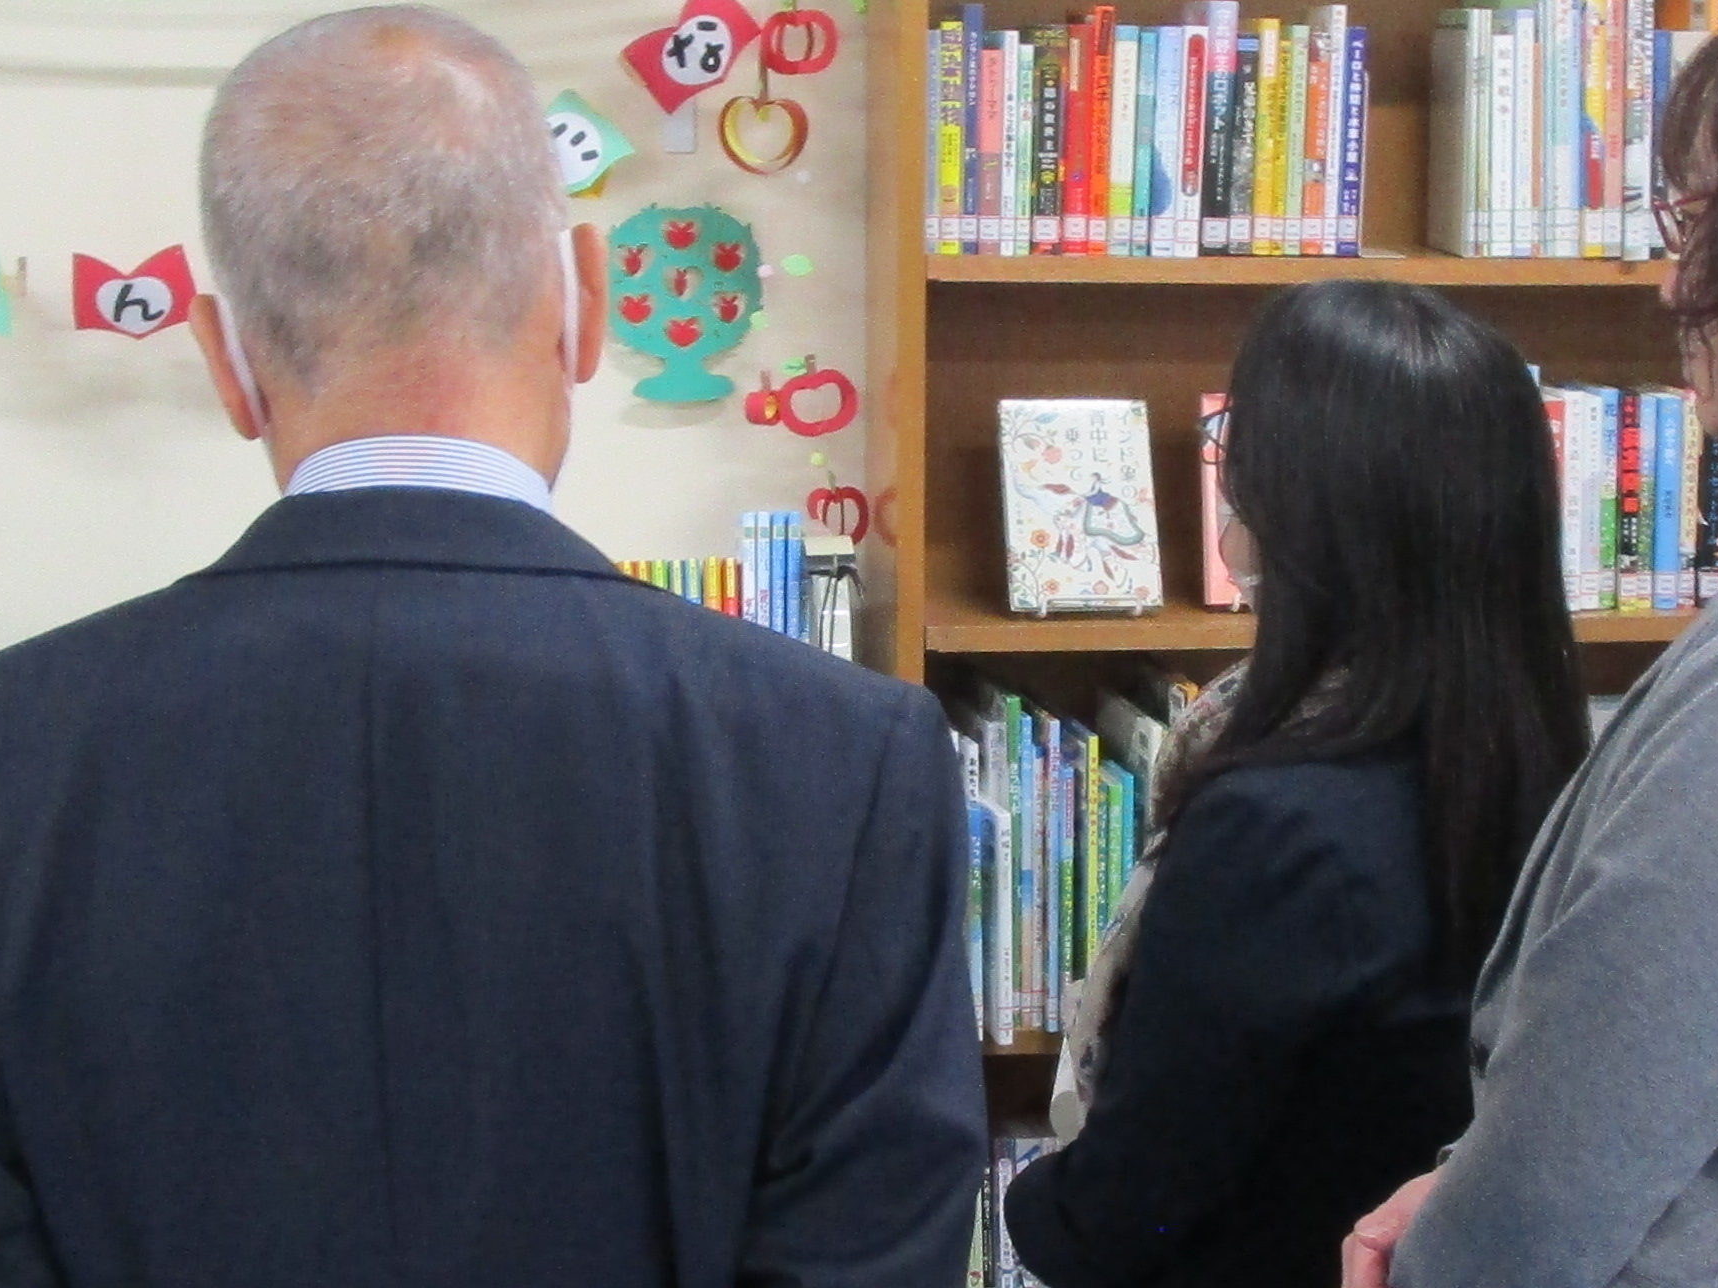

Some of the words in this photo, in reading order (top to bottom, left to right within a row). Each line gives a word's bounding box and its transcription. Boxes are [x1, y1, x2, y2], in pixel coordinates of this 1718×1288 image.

[112, 283, 165, 323] ん
[1064, 427, 1086, 481] 乗って
[1117, 410, 1139, 500] インド象の
